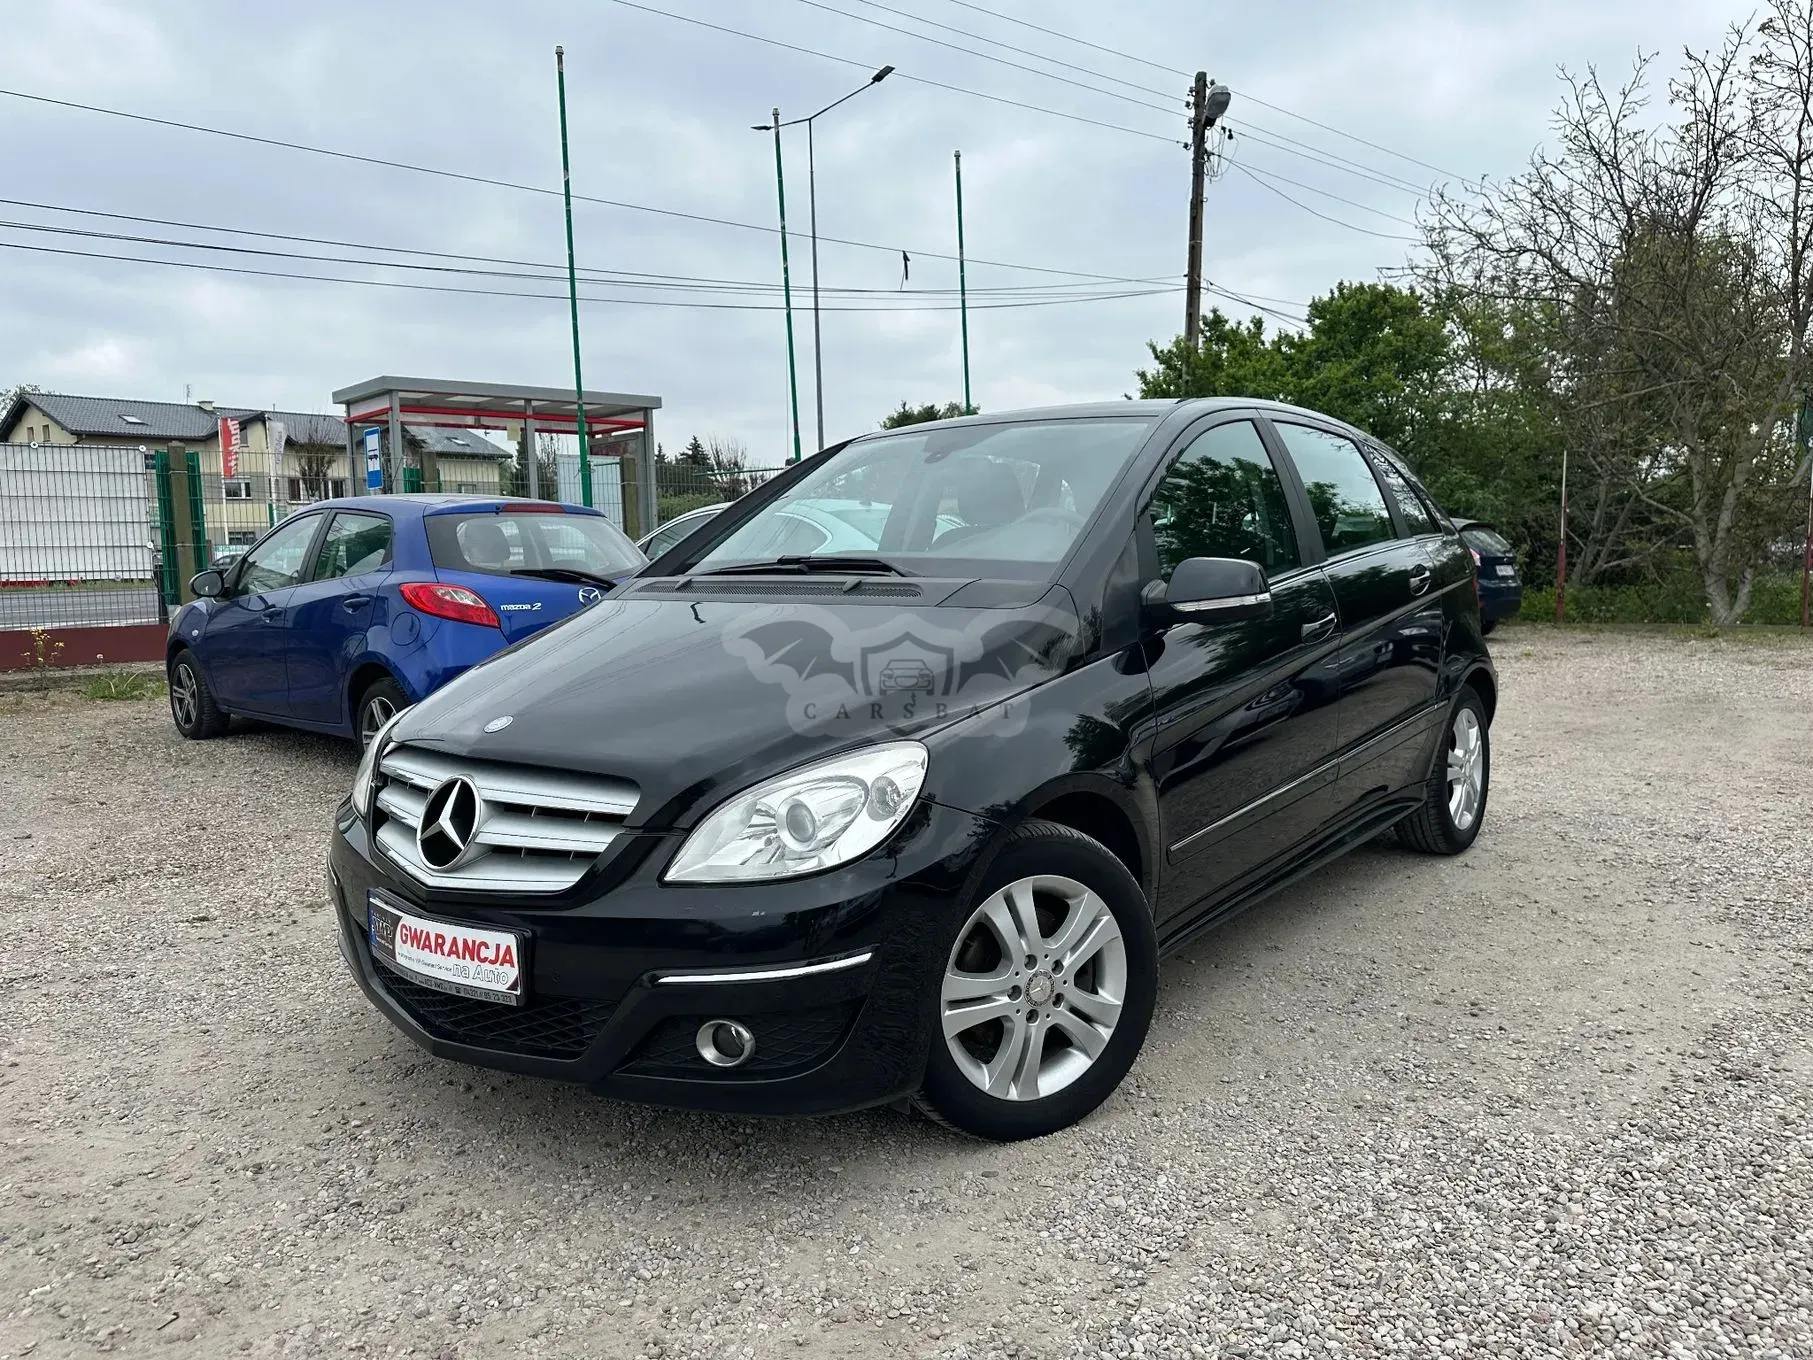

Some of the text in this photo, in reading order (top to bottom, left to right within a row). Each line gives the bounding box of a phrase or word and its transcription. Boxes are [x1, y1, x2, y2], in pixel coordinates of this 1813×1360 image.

[400, 923, 516, 969] GWARANCJA
[452, 963, 470, 979] na
[472, 964, 509, 985] Auto
